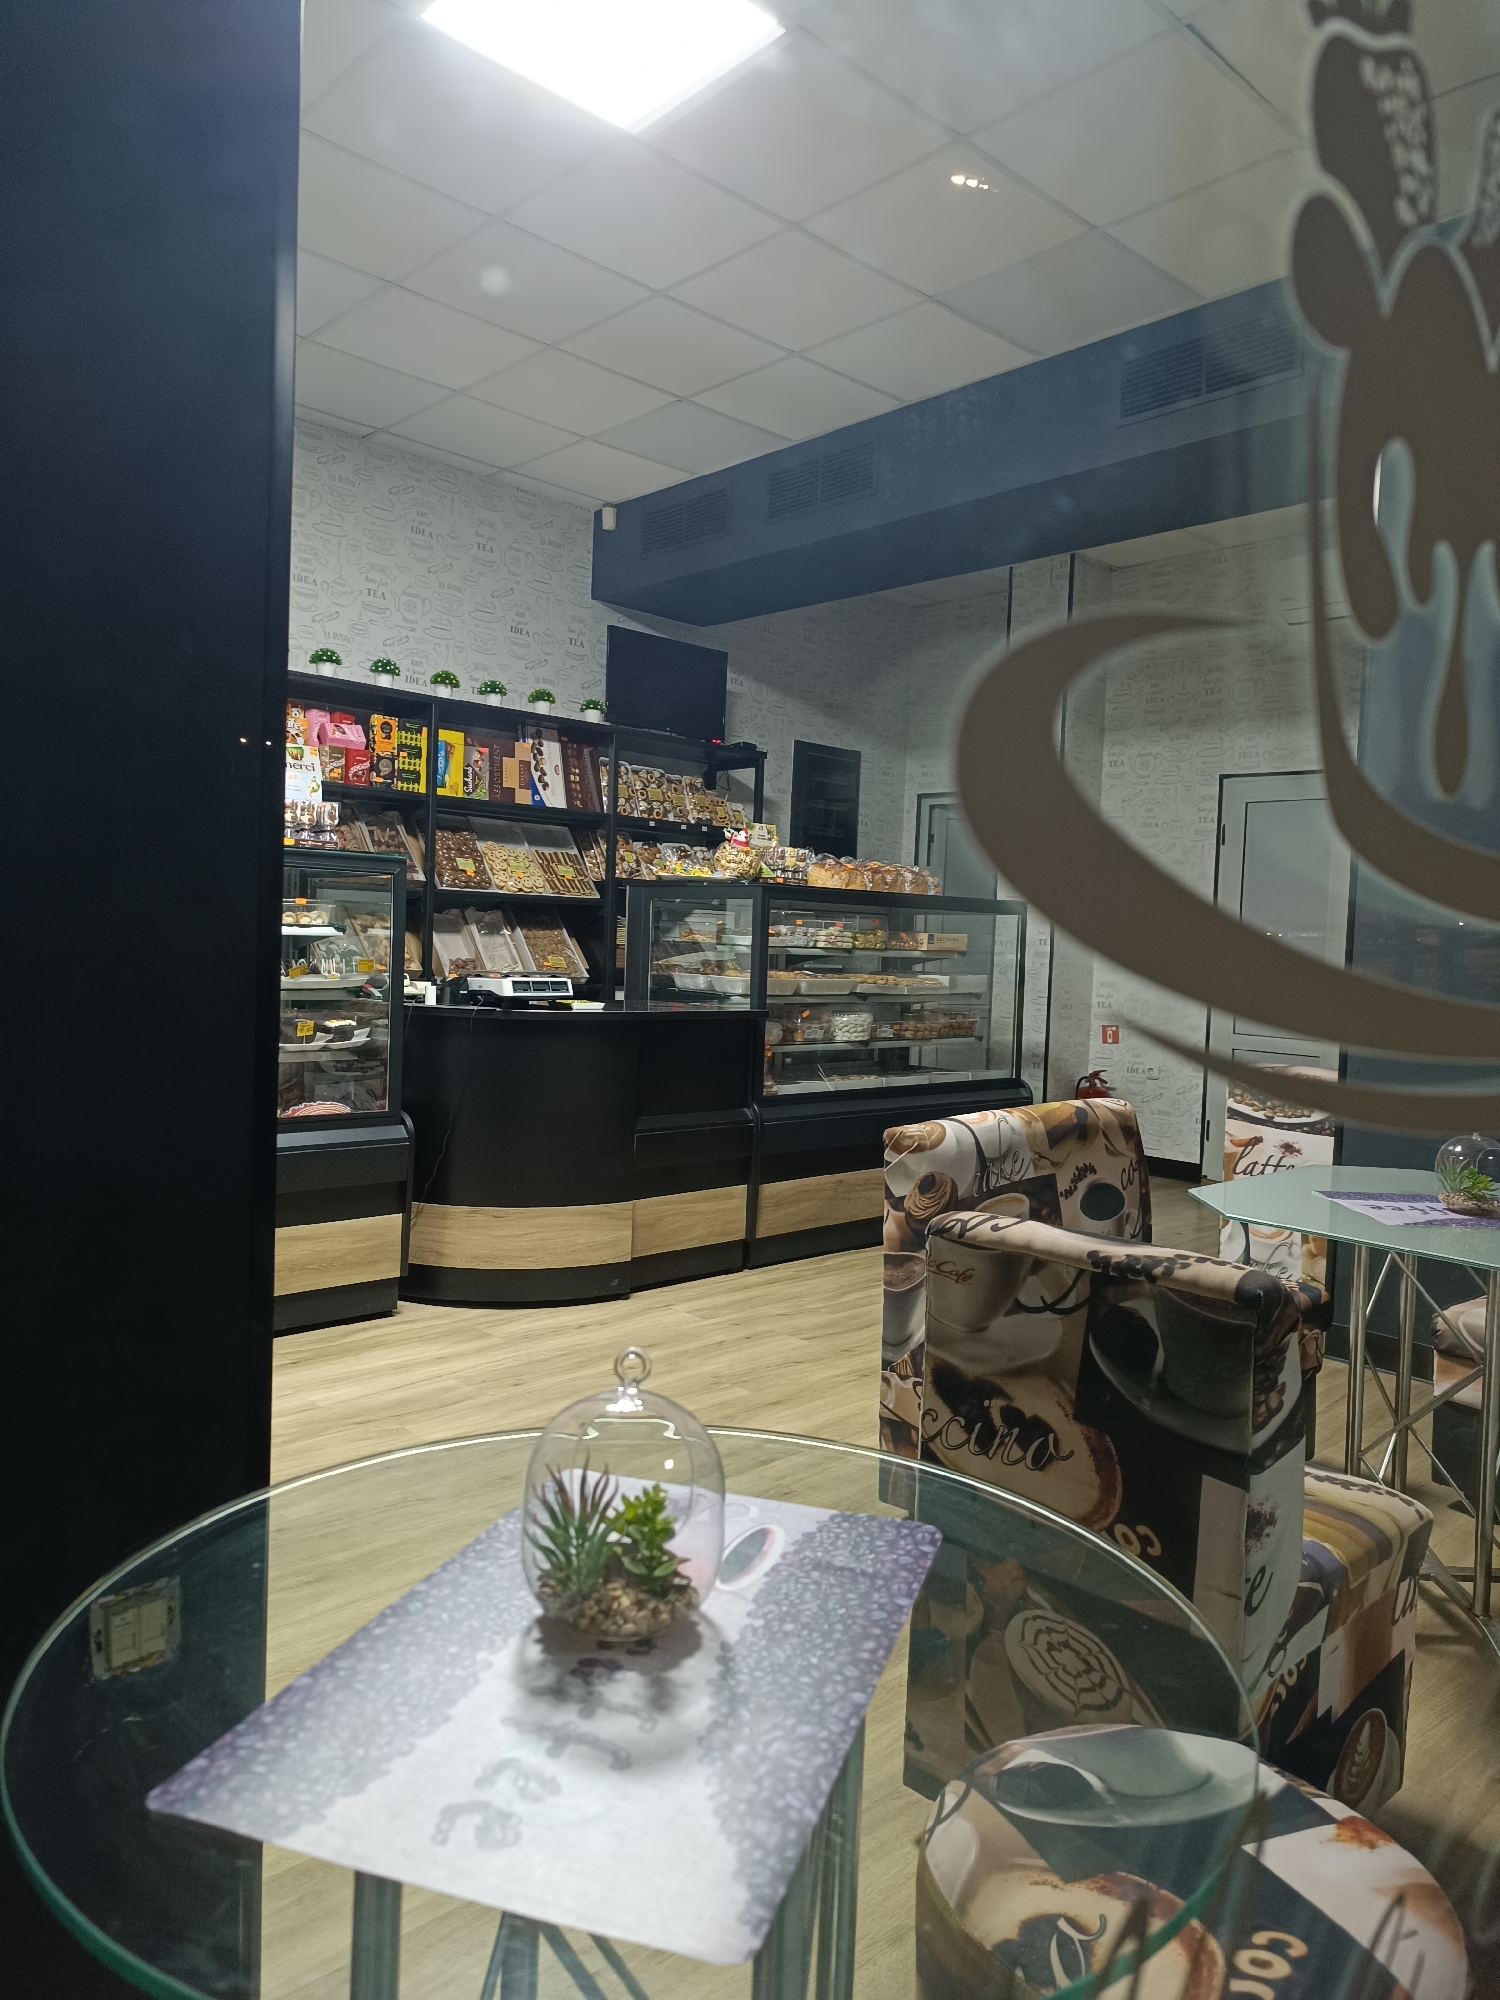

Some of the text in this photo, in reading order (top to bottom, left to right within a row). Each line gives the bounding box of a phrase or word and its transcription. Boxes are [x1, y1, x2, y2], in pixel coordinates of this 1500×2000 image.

[410, 525, 434, 540] IDEA
[475, 541, 495, 554] TEA
[292, 573, 318, 587] IDEA
[365, 587, 387, 601] TEA
[509, 625, 531, 639] IDEA
[568, 637, 585, 649] TEA
[404, 675, 428, 688] IDEA
[729, 677, 744, 687] TEA
[1204, 687, 1222, 696] TEA
[1145, 696, 1165, 705] IDEA
[1238, 750, 1261, 760] IDEA
[1108, 760, 1125, 768] TEA
[463, 766, 473, 793] Suchard
[1139, 821, 1159, 829] IDEA
[1198, 816, 1215, 824] TEA
[1096, 1001, 1112, 1009] TEA
[1126, 1066, 1146, 1075] IDEA
